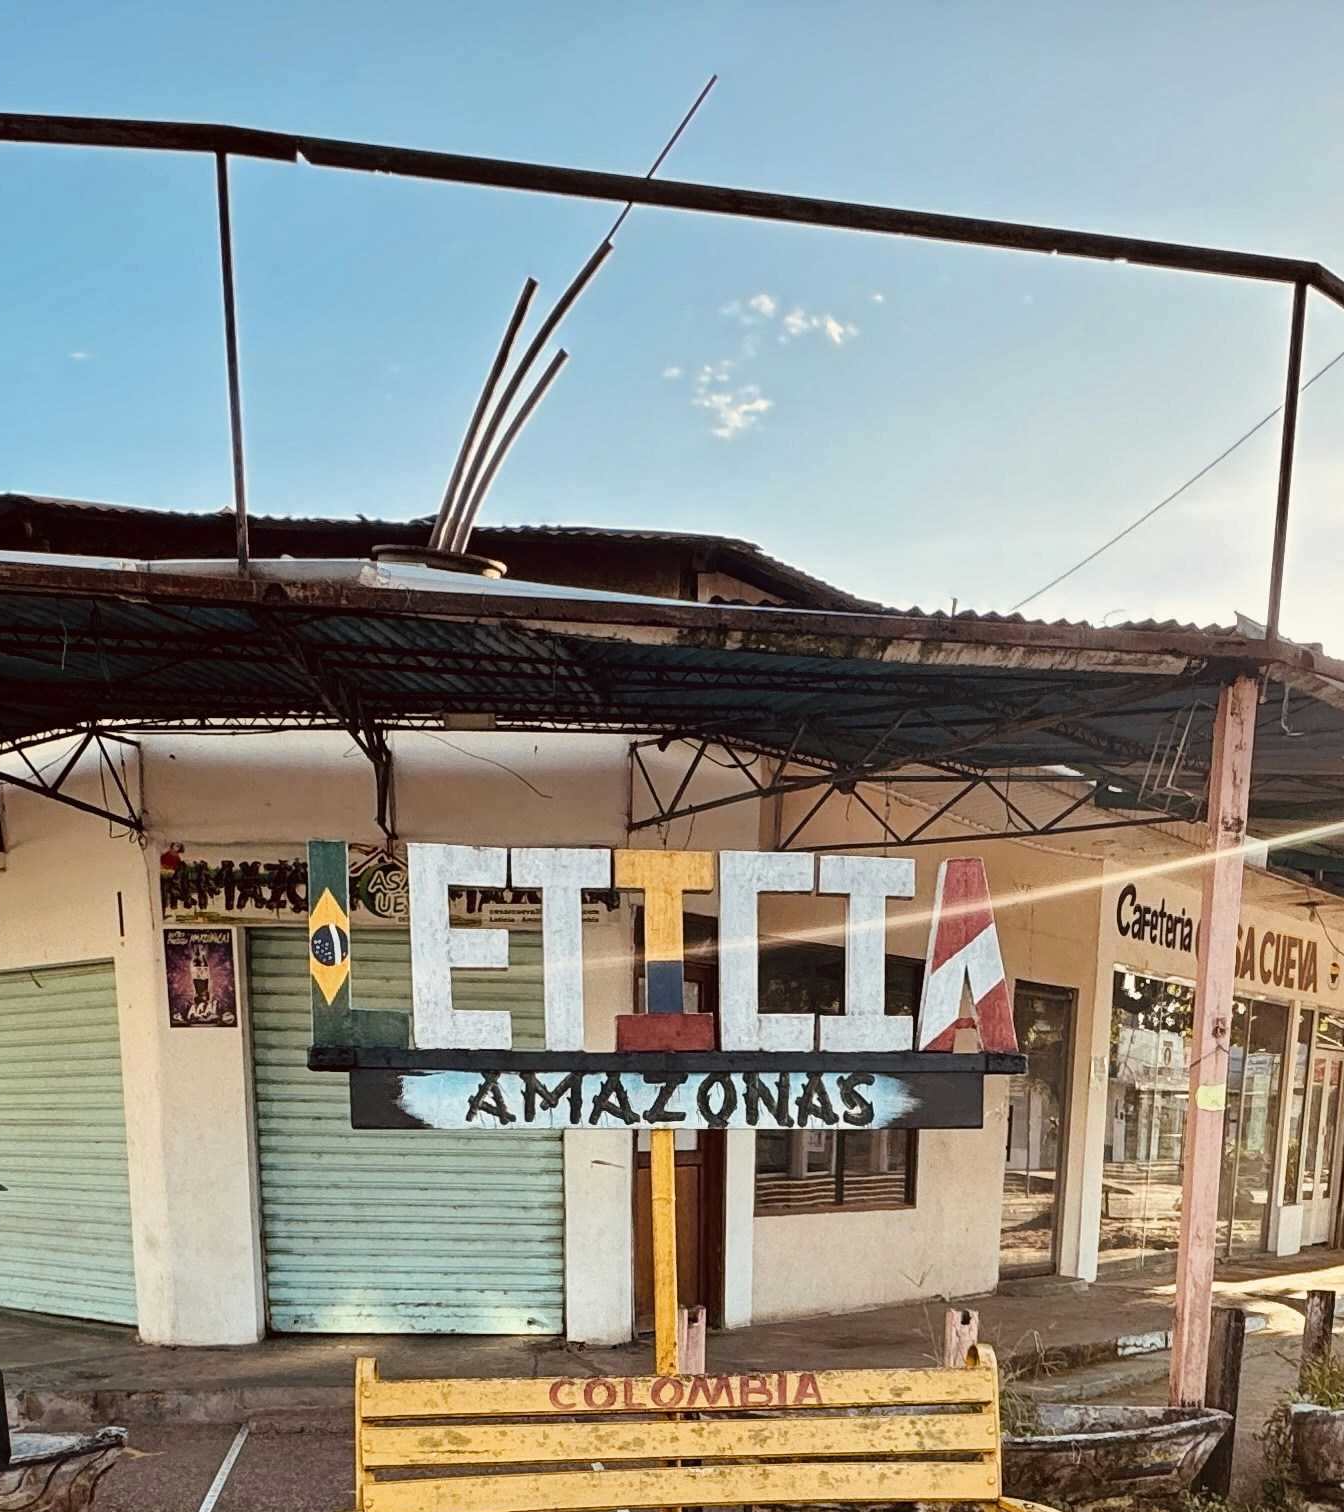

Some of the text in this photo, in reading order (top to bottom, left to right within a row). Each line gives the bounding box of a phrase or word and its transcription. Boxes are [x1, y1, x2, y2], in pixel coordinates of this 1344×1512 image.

[308, 840, 1018, 1054] LETICIA
[1259, 930, 1318, 993] CUEVA
[465, 1071, 875, 1129] AMAZONAS
[548, 1373, 824, 1410] COLOMBIA
